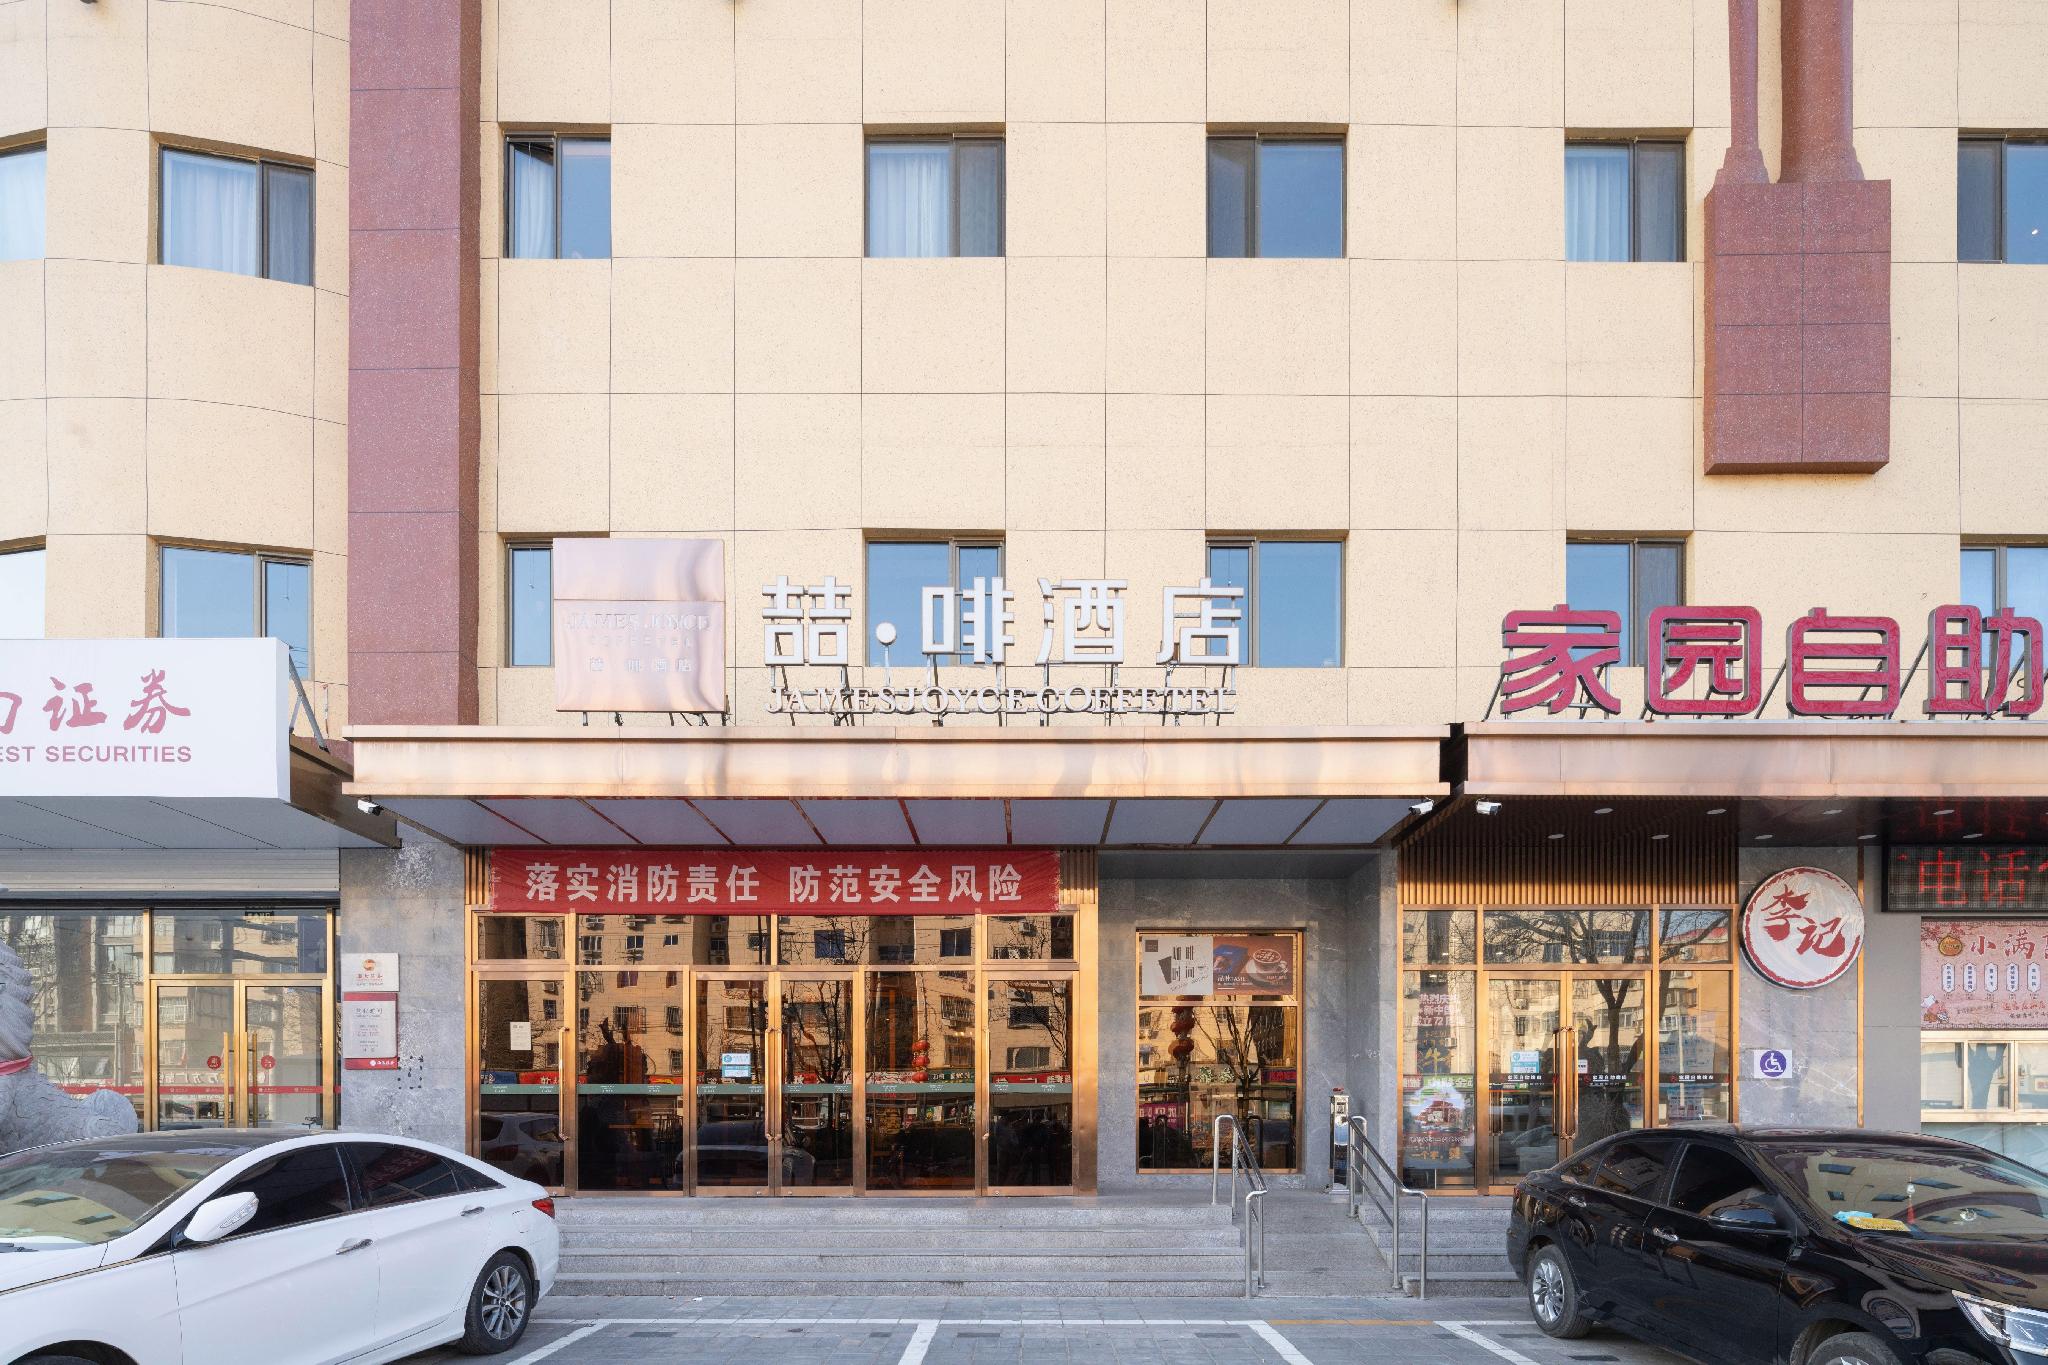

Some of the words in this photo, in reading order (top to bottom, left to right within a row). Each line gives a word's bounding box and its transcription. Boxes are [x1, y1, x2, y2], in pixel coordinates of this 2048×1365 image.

[1500, 604, 2044, 716] 家园自助
[45, 745, 192, 763] SECURITIES
[525, 862, 760, 904] 落实消防责任
[789, 862, 1023, 904] 防范安全风险
[1761, 884, 1846, 958] 李记
